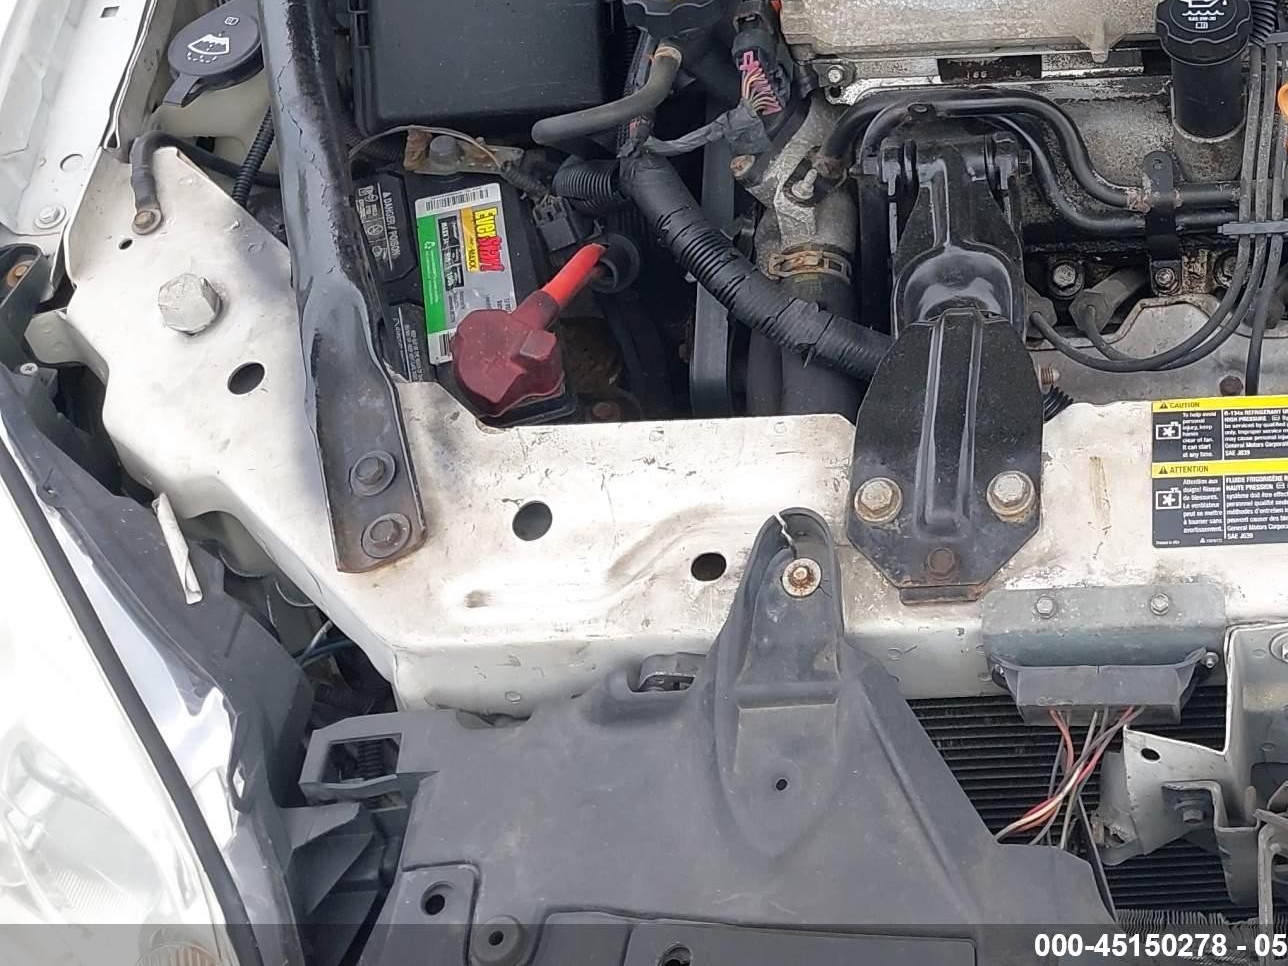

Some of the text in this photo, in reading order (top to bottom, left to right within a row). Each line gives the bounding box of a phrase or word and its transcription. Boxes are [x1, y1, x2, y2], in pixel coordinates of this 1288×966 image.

[383, 197, 396, 225] DANGER
[1169, 465, 1208, 473] ATTENTION
[1226, 492, 1249, 500] système
[1226, 500, 1253, 508] personnel
[1254, 499, 1273, 507] qualifié
